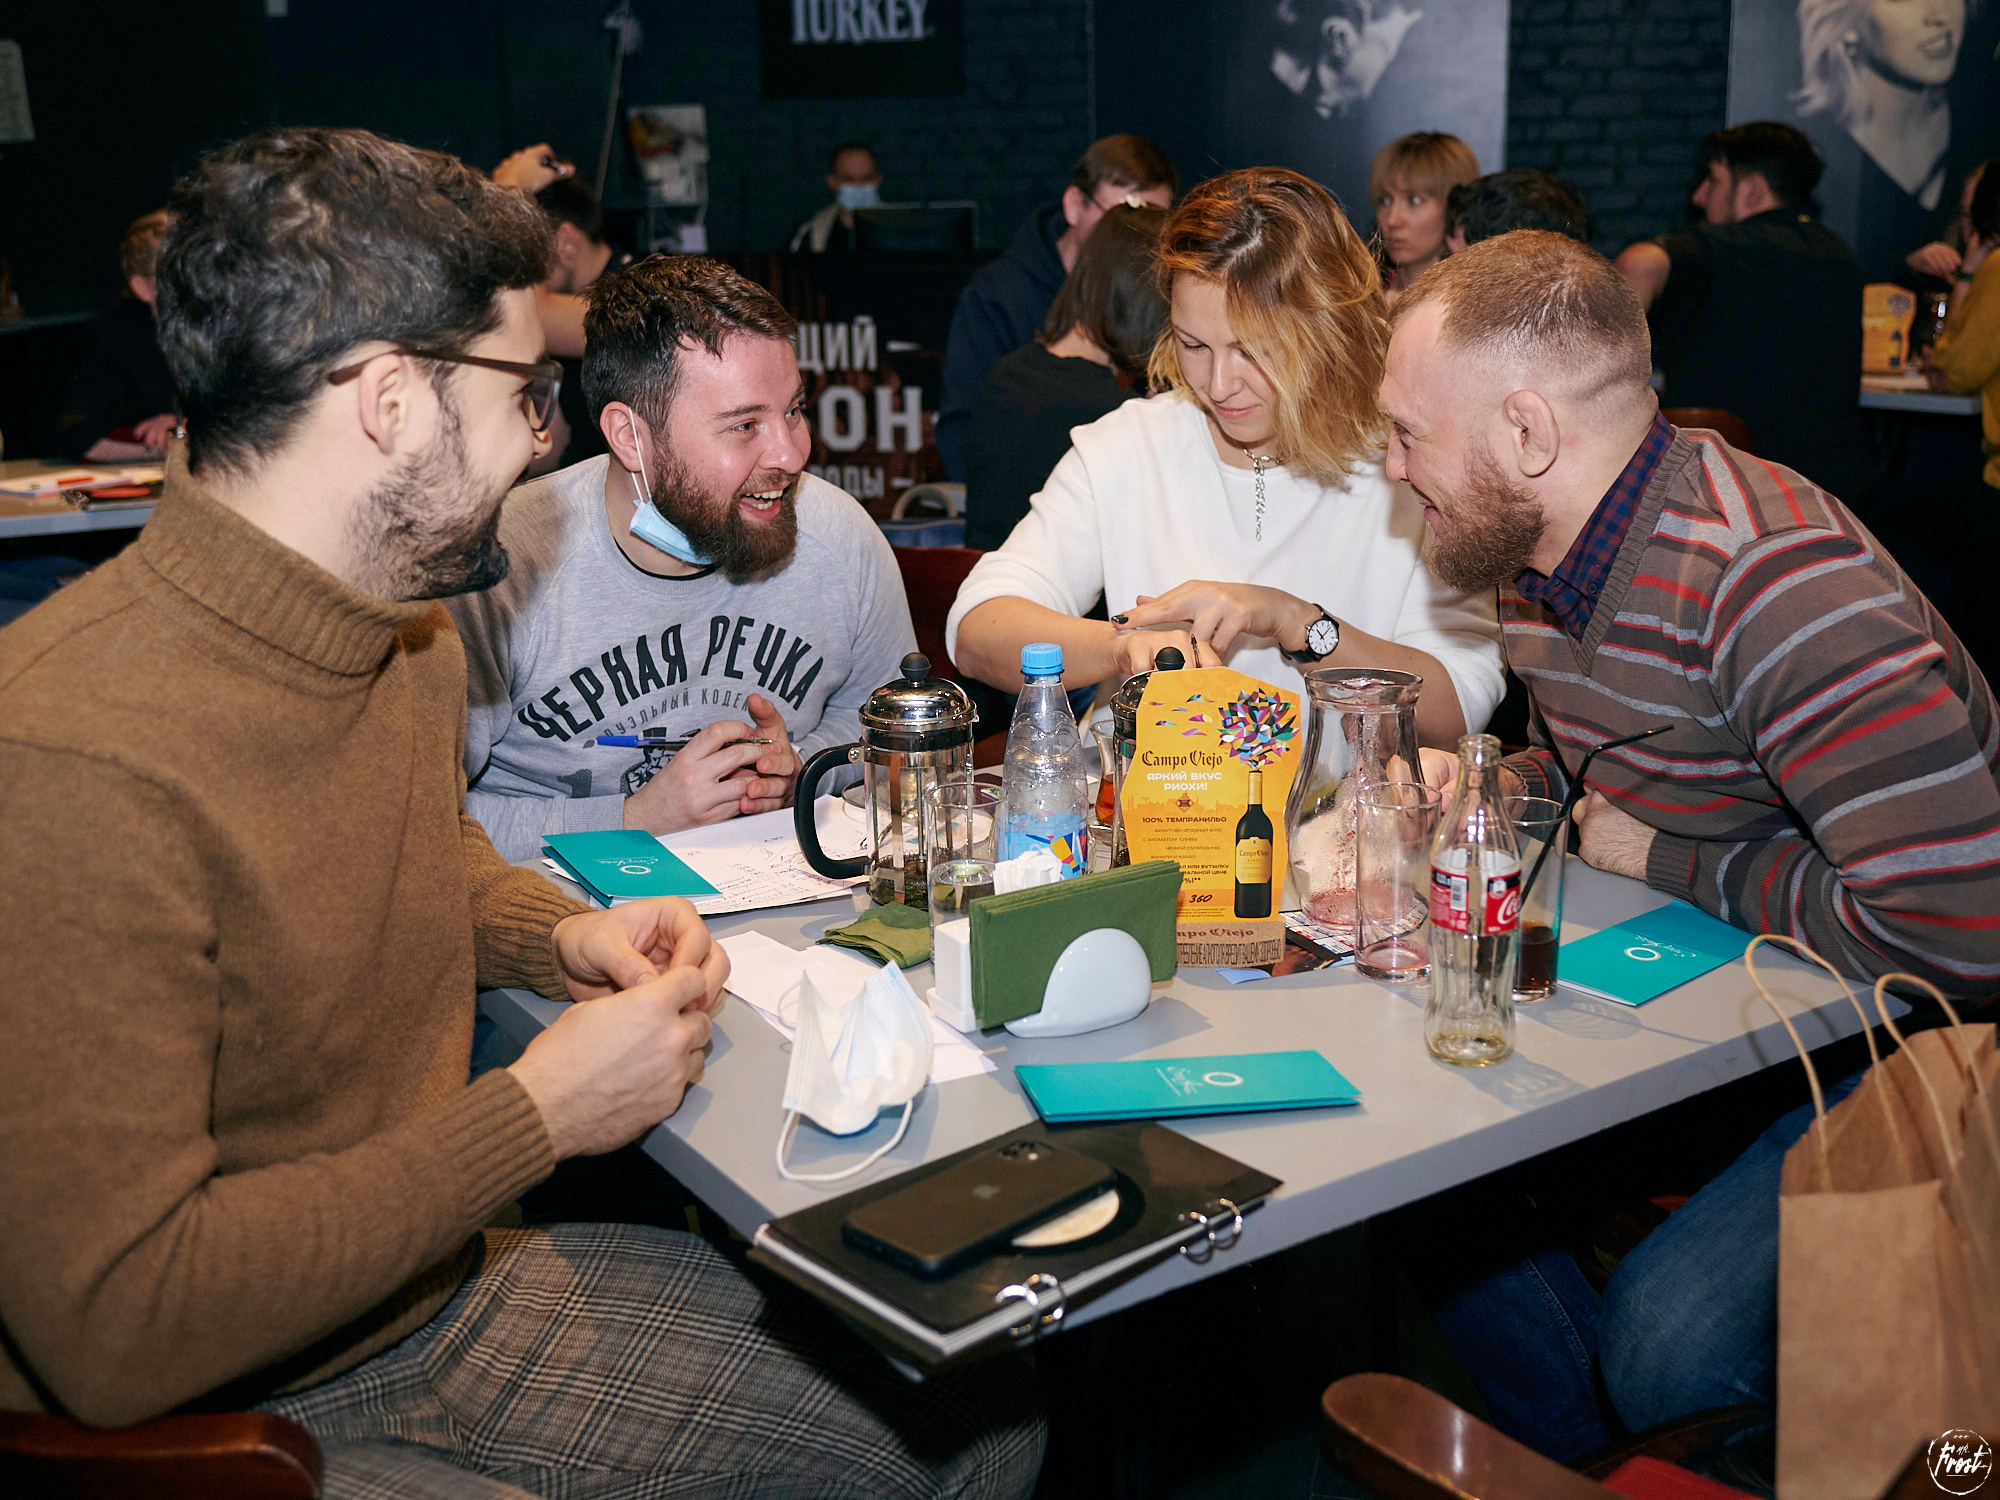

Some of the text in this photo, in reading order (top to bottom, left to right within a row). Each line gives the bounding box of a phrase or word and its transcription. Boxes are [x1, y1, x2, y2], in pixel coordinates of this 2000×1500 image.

[793, 315, 878, 374] ЩИЙ
[817, 384, 923, 452] ОН
[517, 615, 824, 742] ЧЕРНАЯ РЕЧКА
[1142, 750, 1223, 770] Campo Viejo
[1147, 771, 1222, 780] ЯРКИЙ ВКУС
[1164, 782, 1208, 790] РИОХИ!
[1189, 894, 1213, 903] 360
[1176, 928, 1254, 939] mpo Viejo
